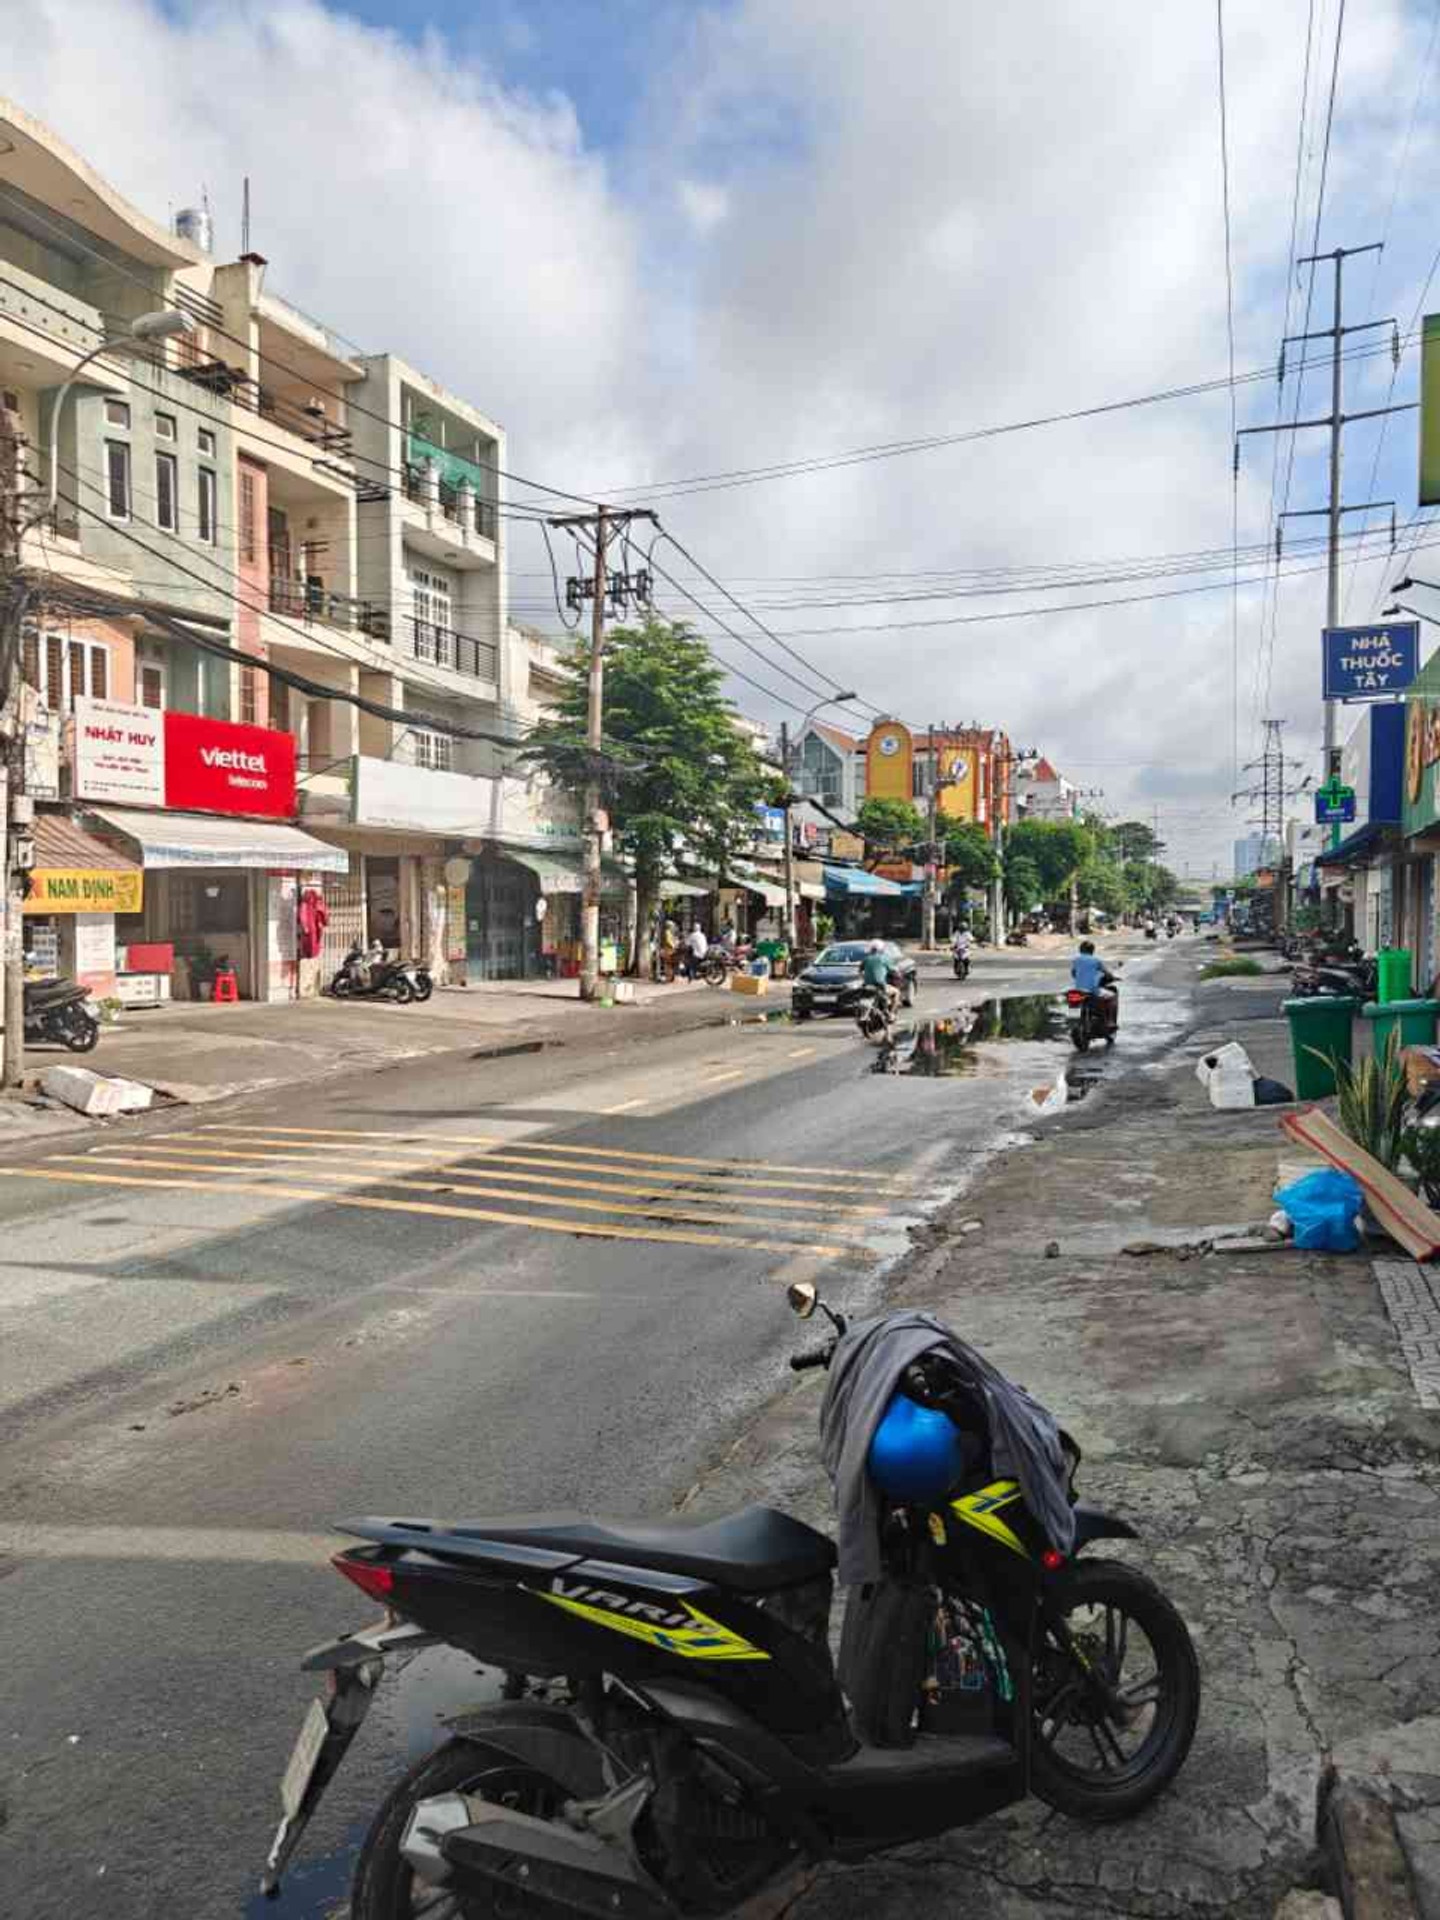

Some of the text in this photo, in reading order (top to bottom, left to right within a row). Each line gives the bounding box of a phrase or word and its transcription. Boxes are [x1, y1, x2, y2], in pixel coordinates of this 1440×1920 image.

[1340, 648, 1404, 671] THUỐC
[1354, 671, 1389, 689] TÂY
[128, 732, 156, 748] HUY
[47, 878, 79, 899] NAM
